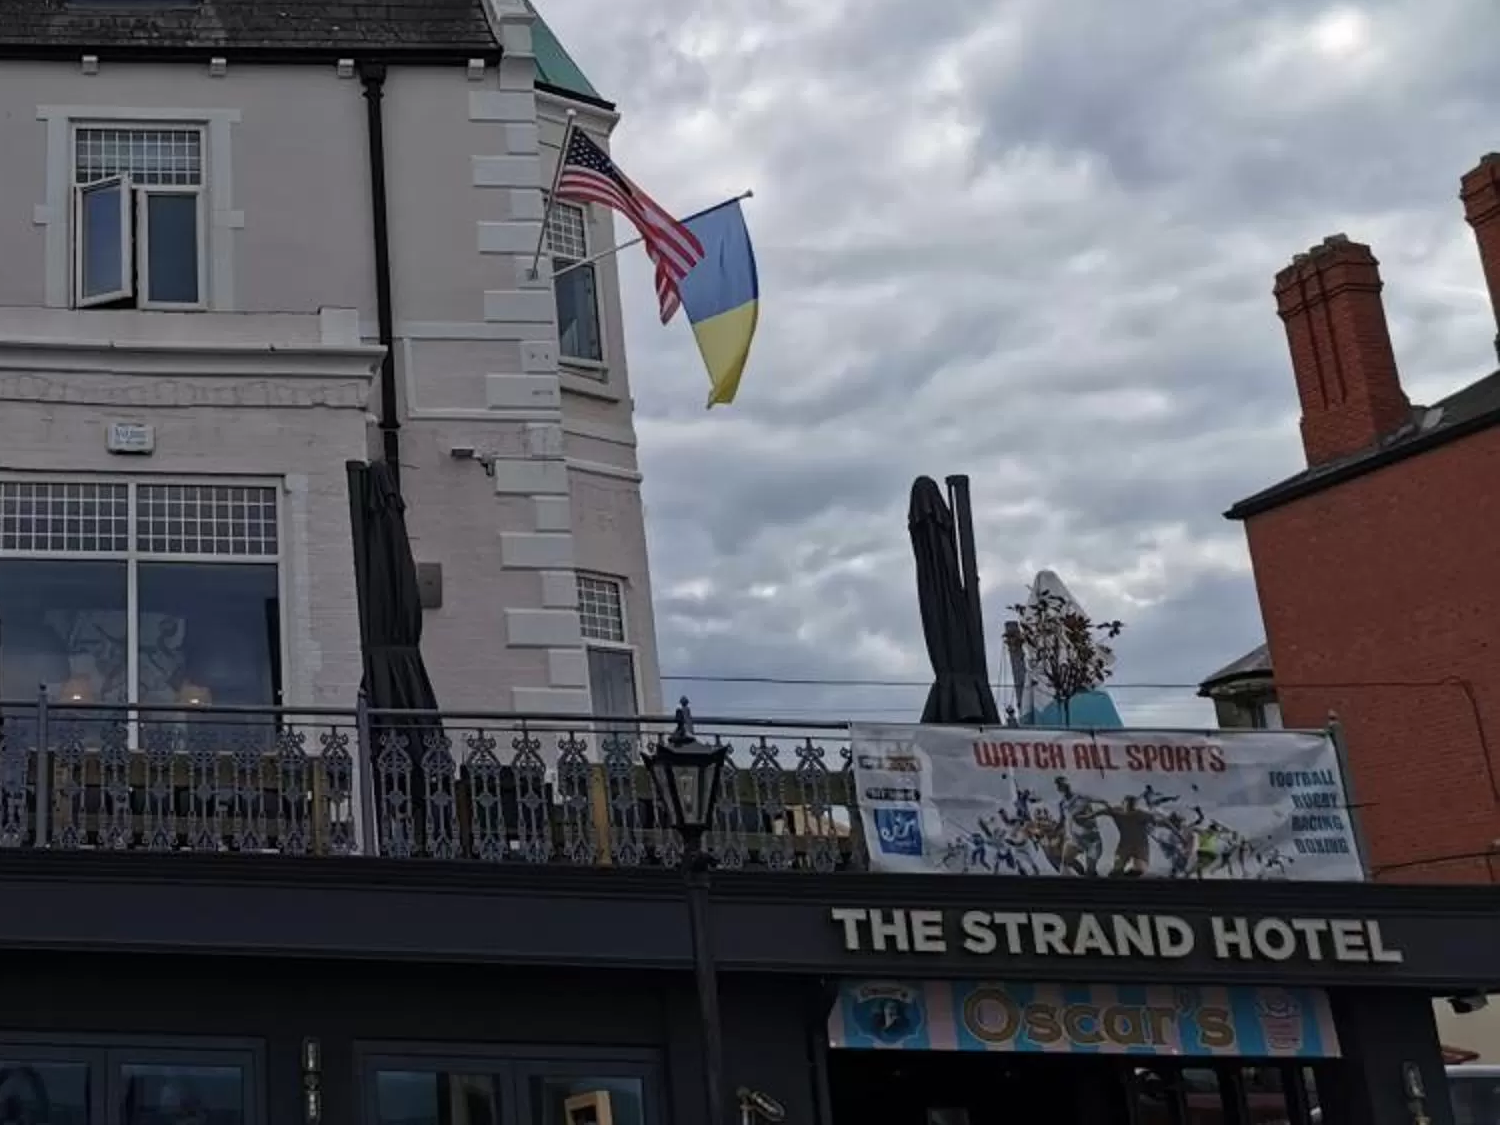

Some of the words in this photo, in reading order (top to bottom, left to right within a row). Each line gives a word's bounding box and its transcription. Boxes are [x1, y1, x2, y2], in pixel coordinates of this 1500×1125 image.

[972, 741, 1066, 771] WATCH
[1073, 742, 1116, 771] ALL
[1126, 743, 1227, 773] SPORTS
[1268, 769, 1336, 788] FOOTBALL
[1291, 792, 1338, 809] RUGBY
[1291, 814, 1344, 832] RACING
[1293, 837, 1350, 854] BOXING
[832, 908, 947, 953] THE
[961, 911, 1195, 958] STRAND
[1211, 916, 1404, 965] HOTEL
[962, 986, 1236, 1048] Oscar's
